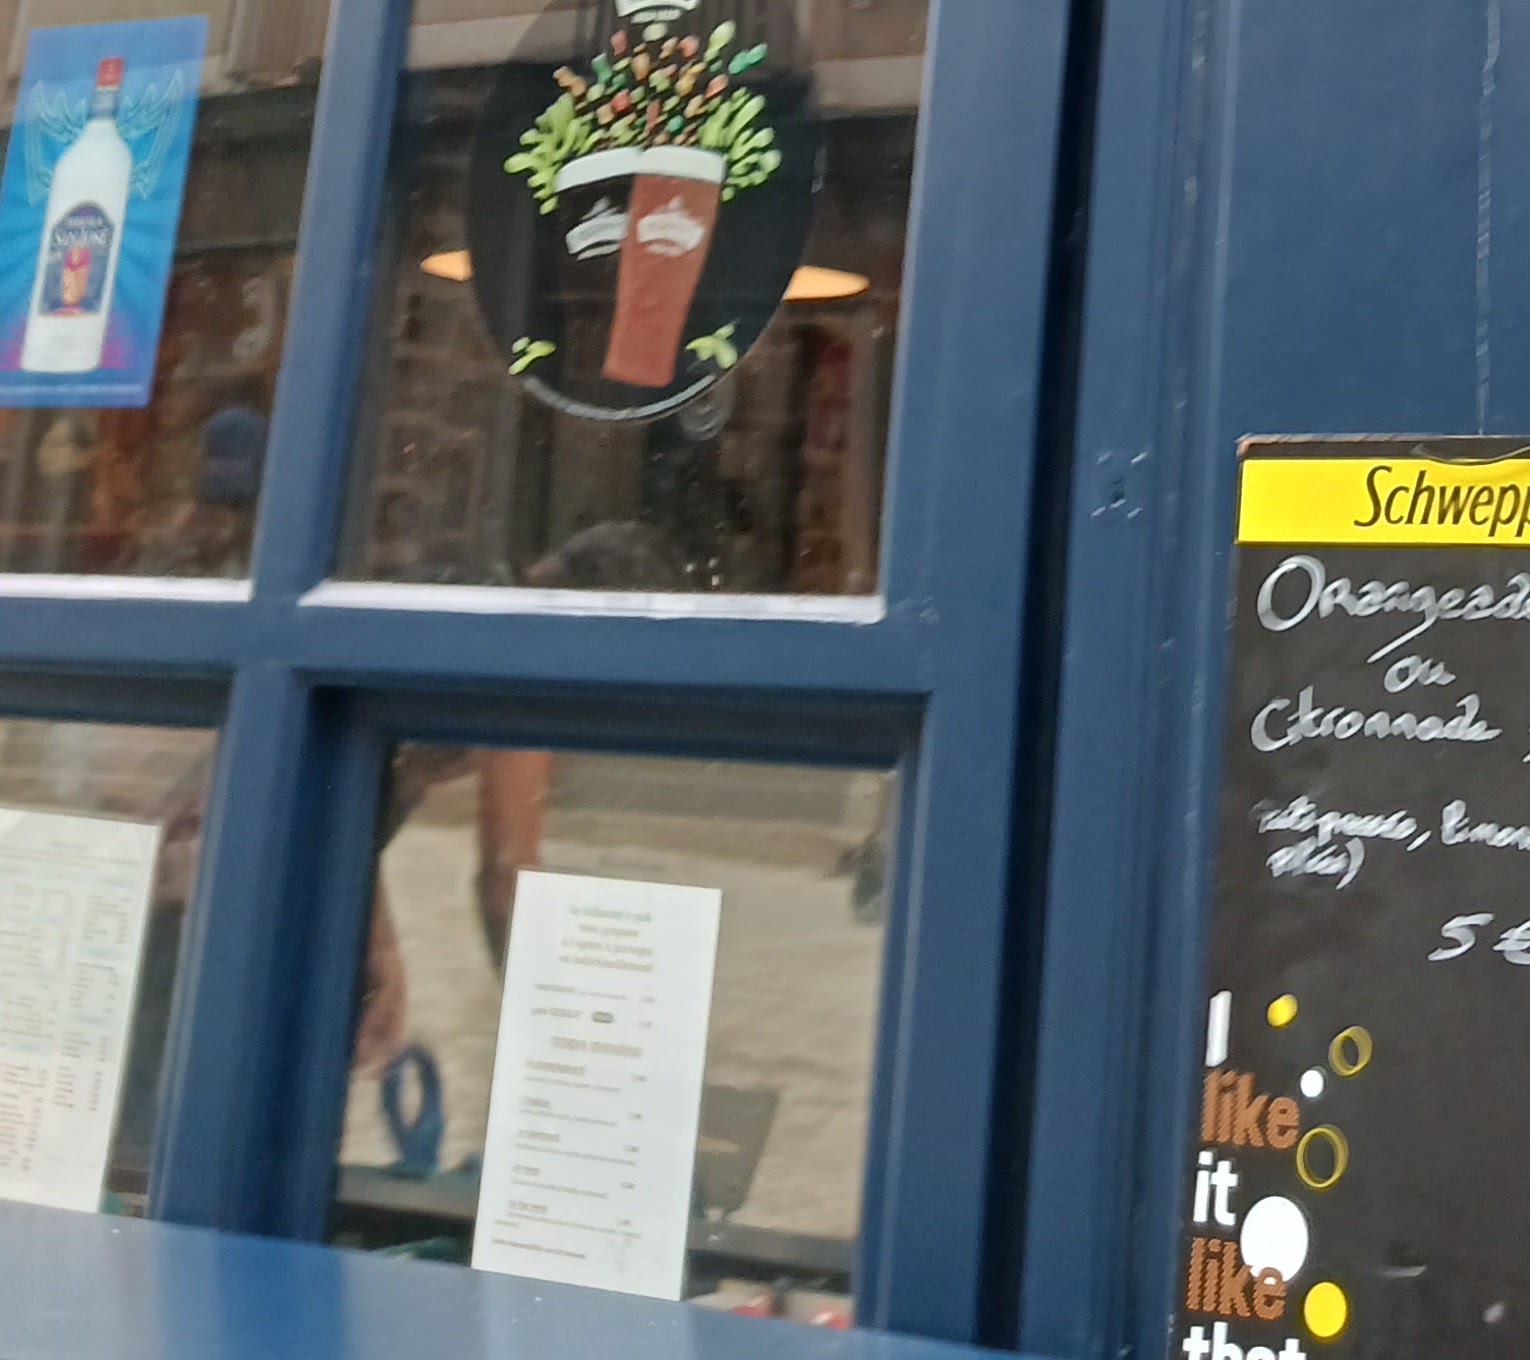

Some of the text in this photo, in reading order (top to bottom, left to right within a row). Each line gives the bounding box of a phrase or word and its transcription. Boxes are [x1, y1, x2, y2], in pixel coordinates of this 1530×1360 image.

[1427, 912, 1495, 962] 5
[1202, 1068, 1300, 1150] like
[1192, 1150, 1239, 1226] it
[1186, 1236, 1288, 1321] like
[1182, 1320, 1307, 1360] th
